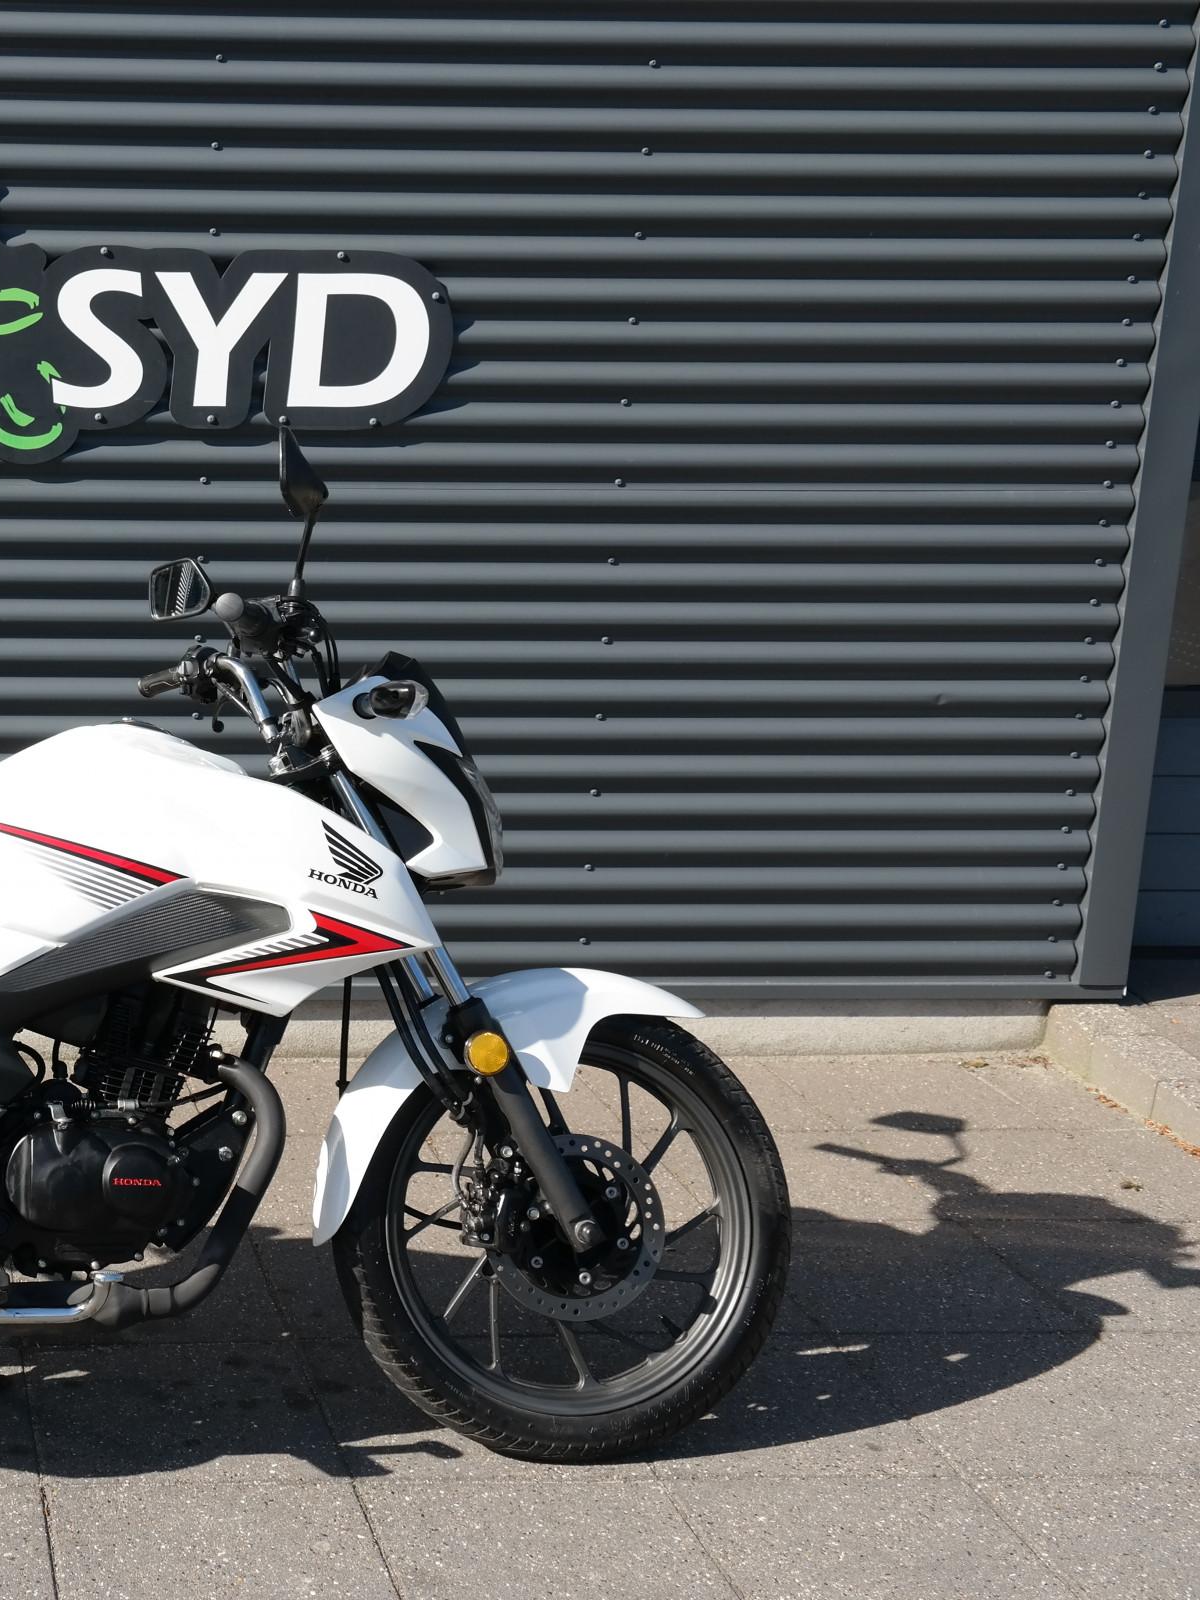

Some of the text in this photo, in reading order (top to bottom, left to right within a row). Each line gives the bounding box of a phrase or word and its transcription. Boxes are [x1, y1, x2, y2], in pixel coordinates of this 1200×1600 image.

[52, 267, 432, 410] SYD
[308, 868, 379, 900] HONDA
[112, 1177, 162, 1187] HONDA
